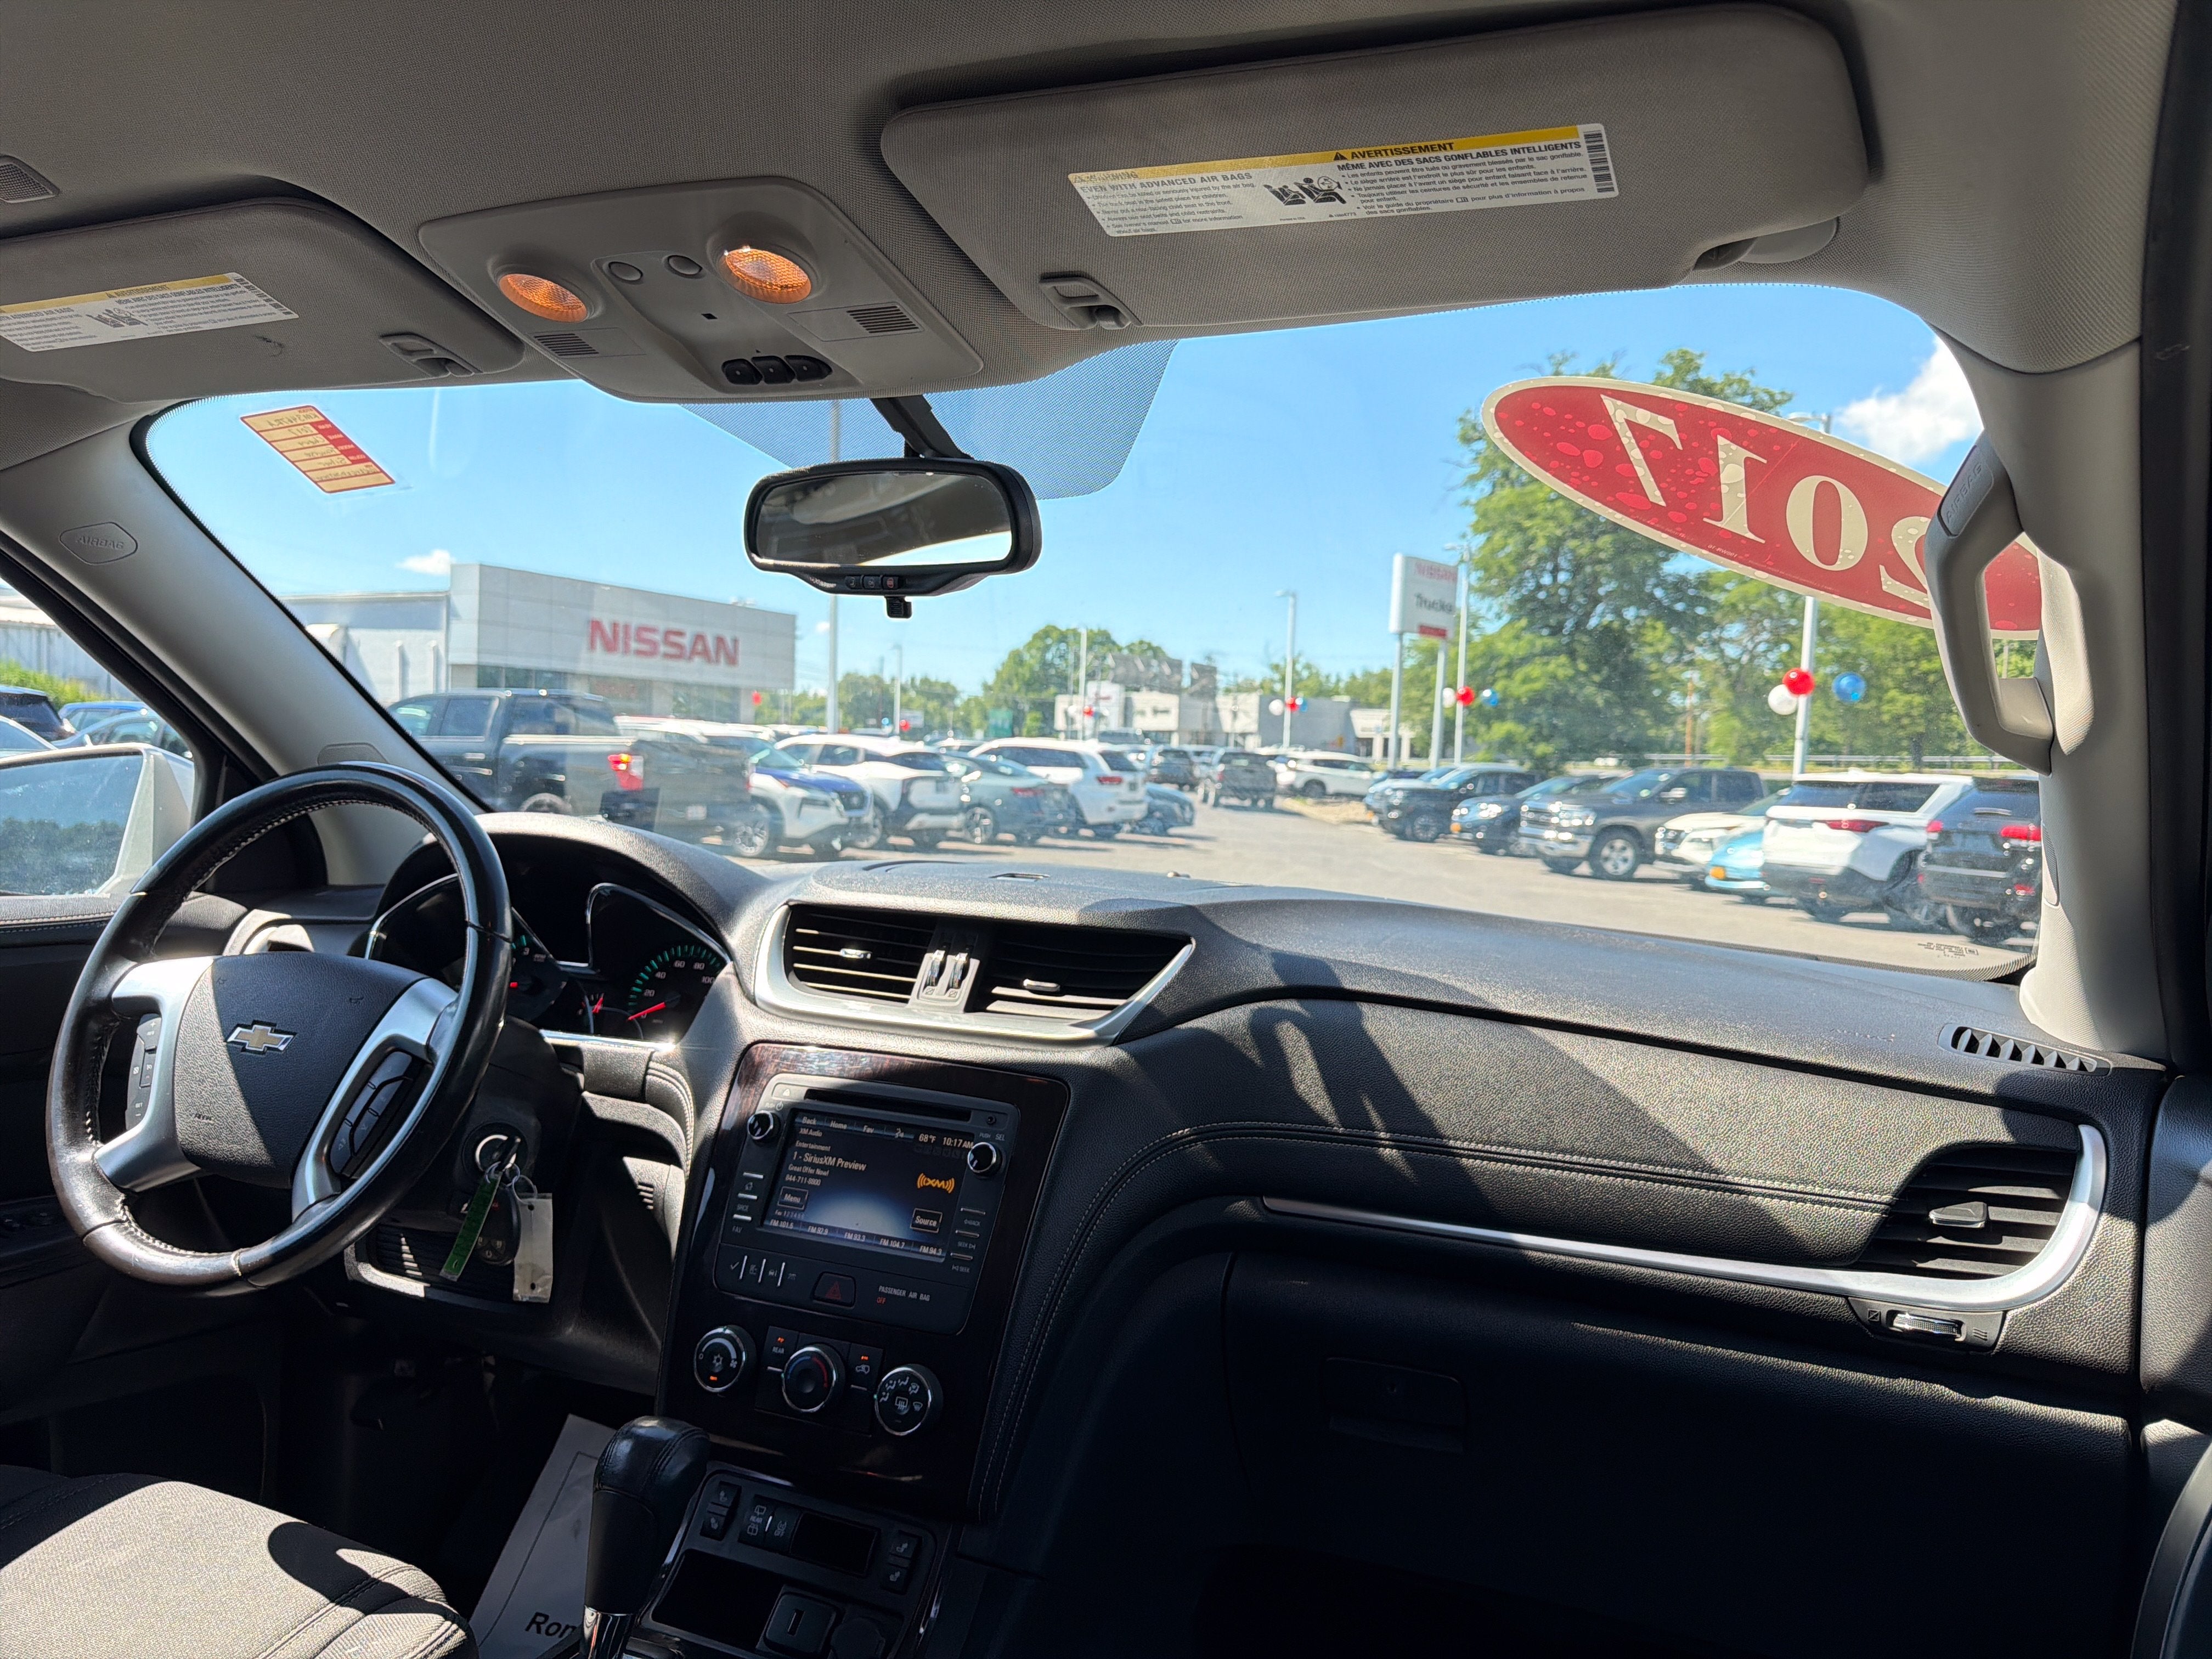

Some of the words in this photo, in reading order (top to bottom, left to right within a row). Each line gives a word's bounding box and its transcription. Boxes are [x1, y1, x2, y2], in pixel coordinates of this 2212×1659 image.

[1350, 142, 1454, 159] AVERTISSEMENT
[1338, 161, 1364, 171] MÊME
[1368, 160, 1392, 168] AVEC
[1395, 158, 1413, 166] DES
[1416, 155, 1441, 164] SACS
[1444, 149, 1507, 161] GONFLABLES
[1510, 141, 1581, 155] INTELLIGENTS
[1452, 161, 1486, 170] gravement
[1081, 184, 1107, 193] EVEN
[1110, 182, 1136, 191] WITH
[1138, 177, 1196, 189] ADVANCED
[1199, 175, 1218, 183] AIR
[1221, 172, 1252, 182] BAGS
[76, 535, 125, 550] AIRBAG
[589, 618, 740, 667] NISSAN
[655, 971, 666, 979] 40
[702, 975, 715, 984] 100
[802, 1116, 817, 1125] Back
[830, 1120, 847, 1130] Home
[862, 1125, 874, 1133] Fav
[918, 1133, 936, 1143] 68°F
[795, 1140, 831, 1152] Entertainment
[803, 1152, 836, 1166] SiriusXM
[836, 1158, 867, 1171] Preview
[788, 1164, 802, 1172] Great
[803, 1165, 815, 1174] Offer
[784, 1193, 801, 1203] Menu
[915, 1215, 937, 1227] Source
[879, 1238, 889, 1246] FM
[890, 1239, 905, 1249] 104.7
[919, 1245, 929, 1254] FM
[878, 1285, 906, 1296] PASSENGER
[919, 1293, 930, 1301] BAG
